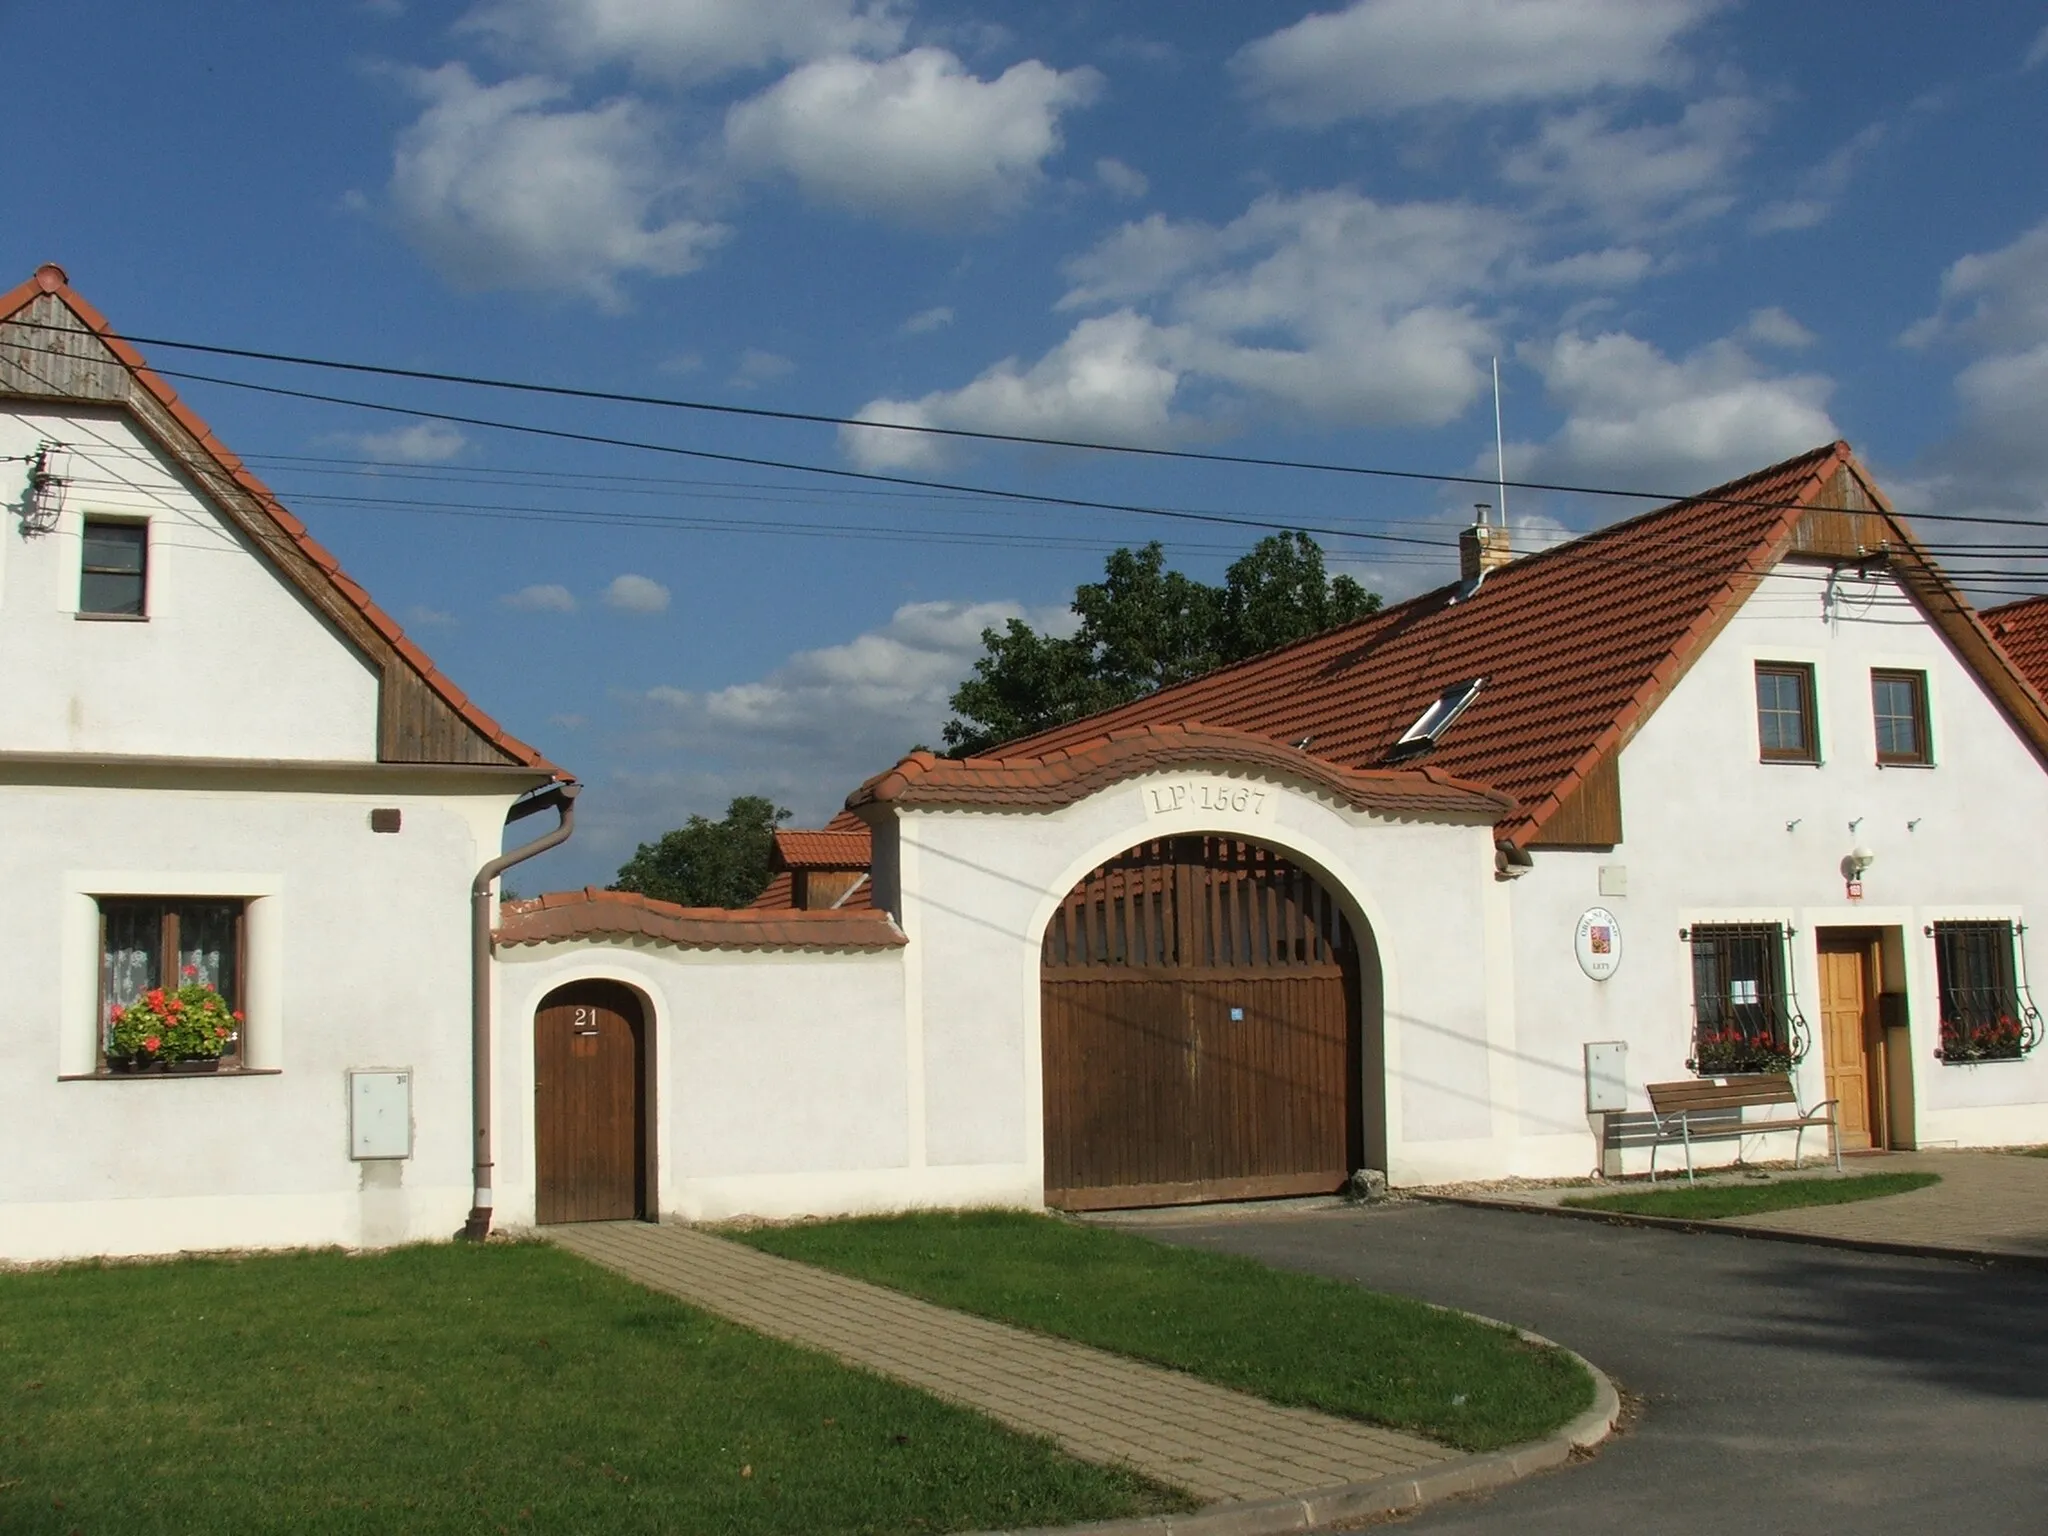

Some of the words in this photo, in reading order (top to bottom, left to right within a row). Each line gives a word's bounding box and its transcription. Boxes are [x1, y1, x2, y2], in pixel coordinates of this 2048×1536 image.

[1151, 785, 1186, 814] LP
[1201, 786, 1266, 815] 1567
[574, 1008, 596, 1026] 21
